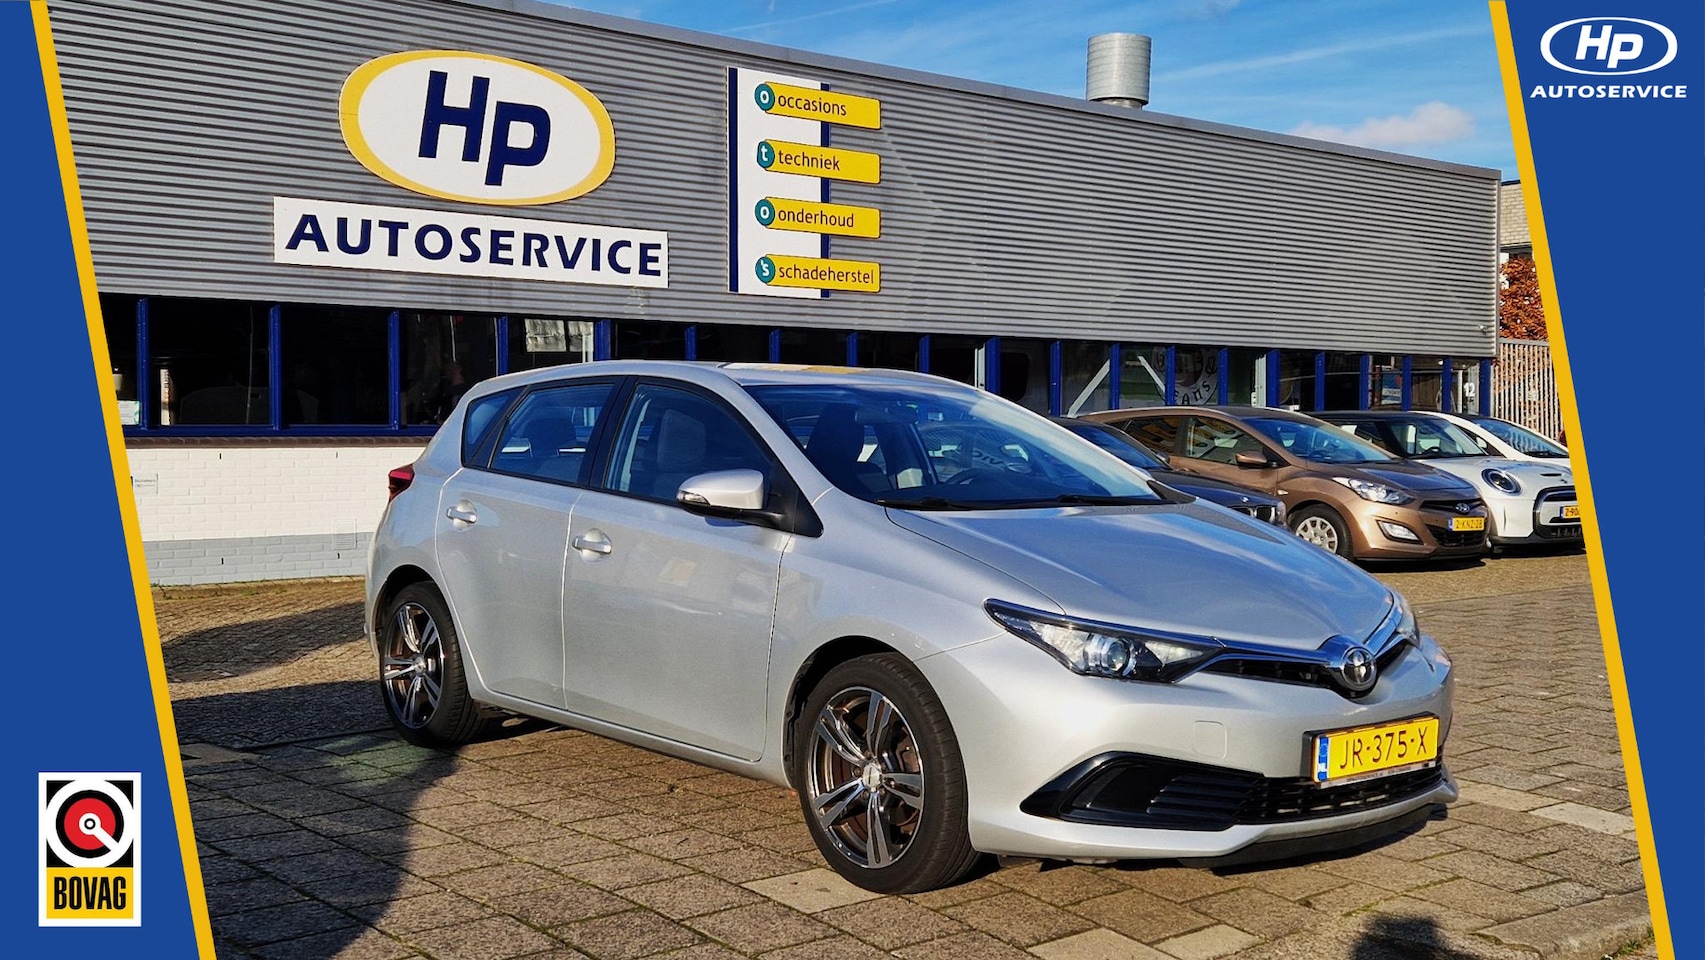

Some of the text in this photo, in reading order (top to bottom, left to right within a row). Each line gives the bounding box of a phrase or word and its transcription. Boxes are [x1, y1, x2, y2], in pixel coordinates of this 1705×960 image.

[778, 95, 847, 116] occasions
[760, 145, 841, 171] t techniek
[778, 208, 854, 228] onderhoud
[285, 214, 662, 276] AUTOSERVICE
[779, 264, 874, 284] schadeherstel
[1463, 382, 1476, 397] 12
[1340, 726, 1428, 769] JR-375-X
